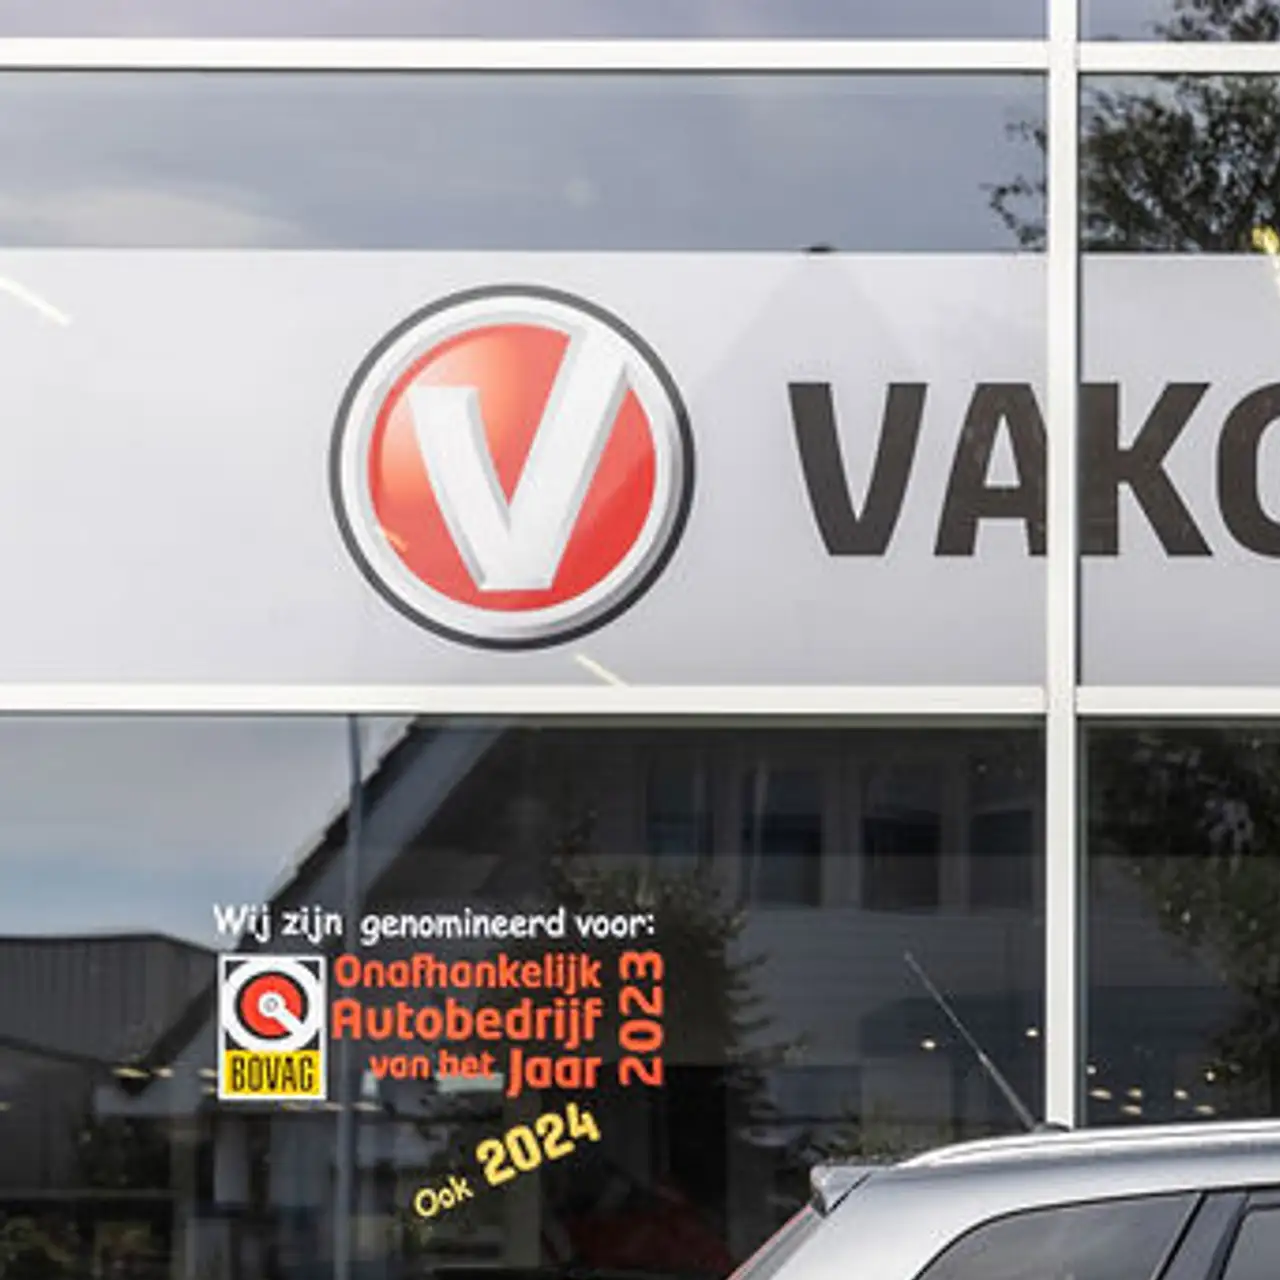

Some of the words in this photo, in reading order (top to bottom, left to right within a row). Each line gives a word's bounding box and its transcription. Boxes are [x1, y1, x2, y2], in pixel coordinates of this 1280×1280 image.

[213, 904, 271, 943] Wij
[281, 906, 342, 943] zijn
[360, 905, 565, 946] genomineerd
[574, 913, 655, 938] voor:
[334, 952, 602, 995] Onafhankelijk
[331, 997, 603, 1049] Autobedrijf
[618, 950, 664, 1086] 2023
[231, 1055, 313, 1092] BOVAG
[369, 1054, 430, 1080] van
[438, 1049, 494, 1080] het
[506, 1047, 602, 1098] Jaar
[414, 1176, 474, 1217] Ook
[475, 1102, 601, 1186] 2024
